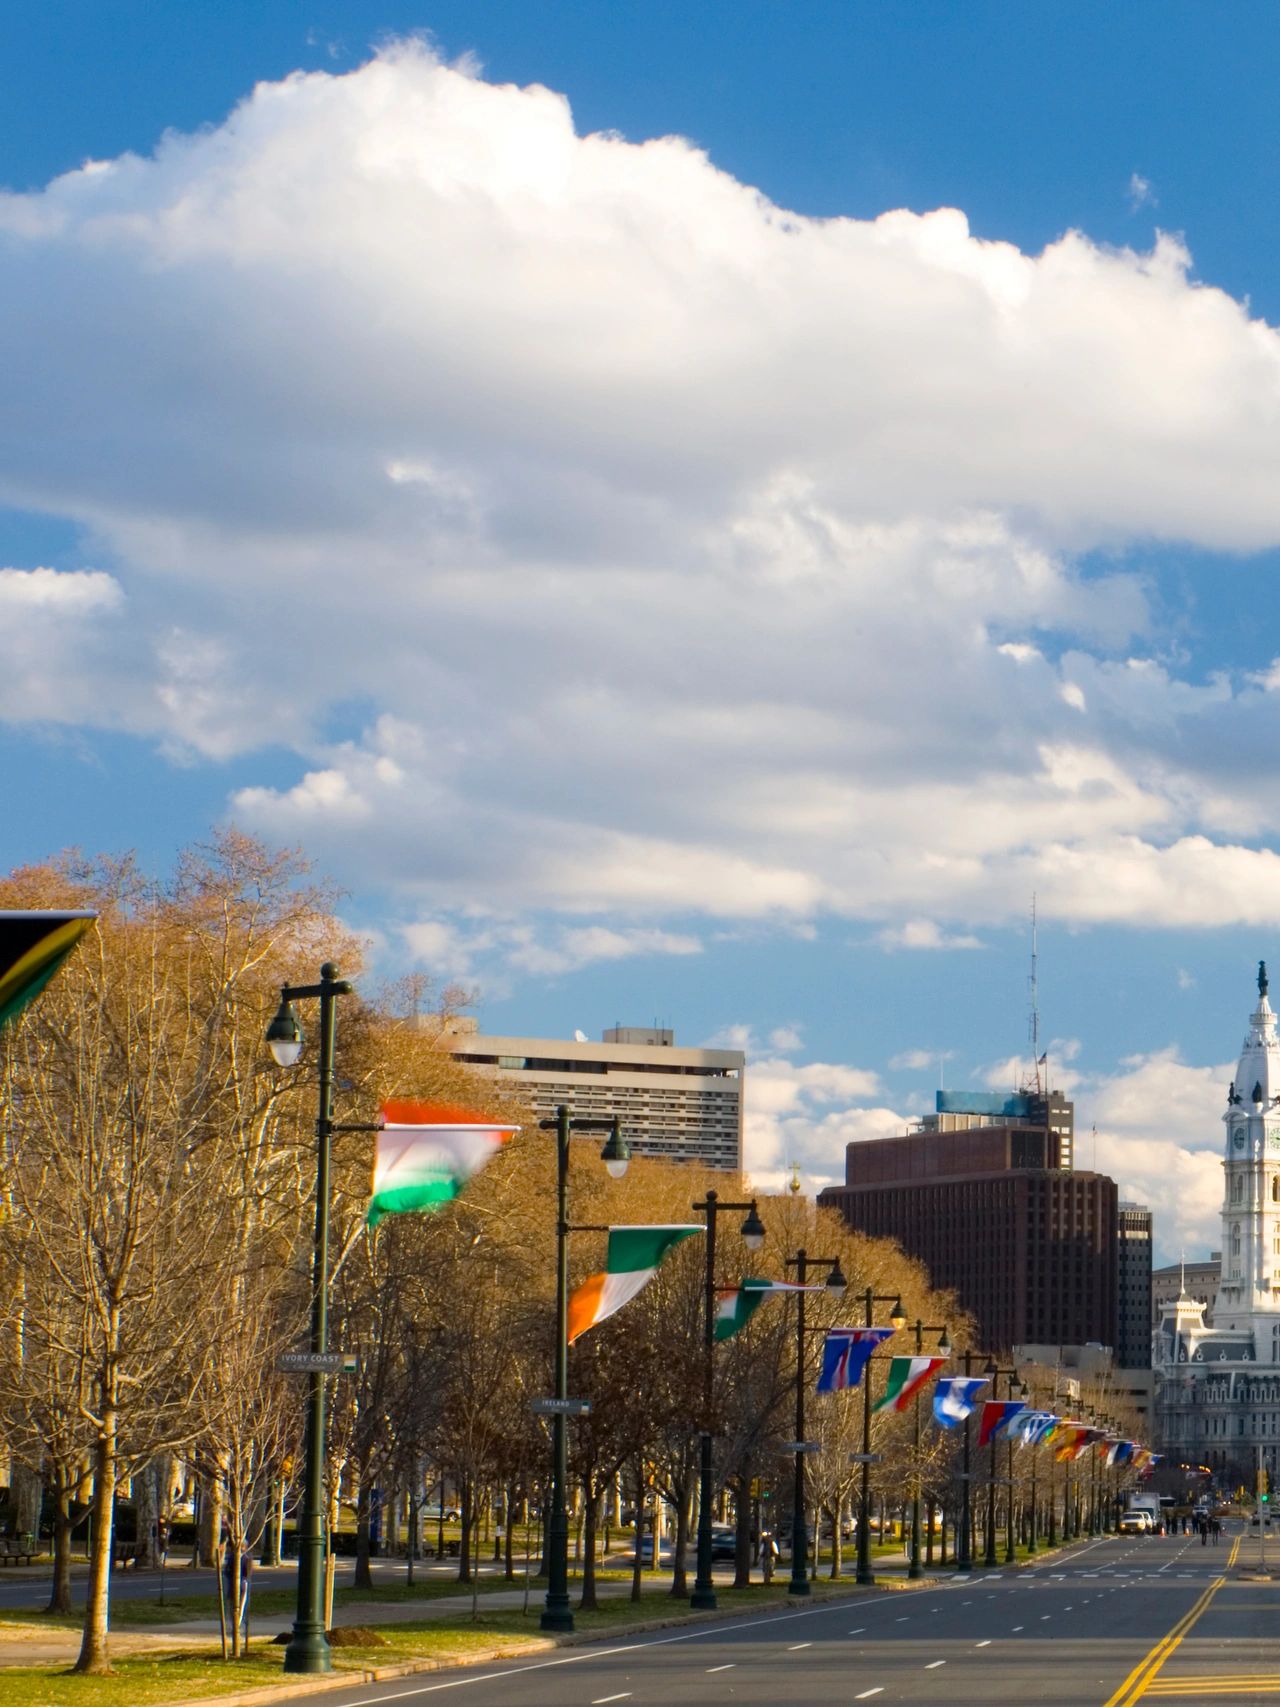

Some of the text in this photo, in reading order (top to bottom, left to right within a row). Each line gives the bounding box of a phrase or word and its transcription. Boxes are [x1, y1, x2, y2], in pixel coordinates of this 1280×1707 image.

[281, 1354, 339, 1363] IVORY COAST
[542, 1400, 570, 1408] IRELAND
